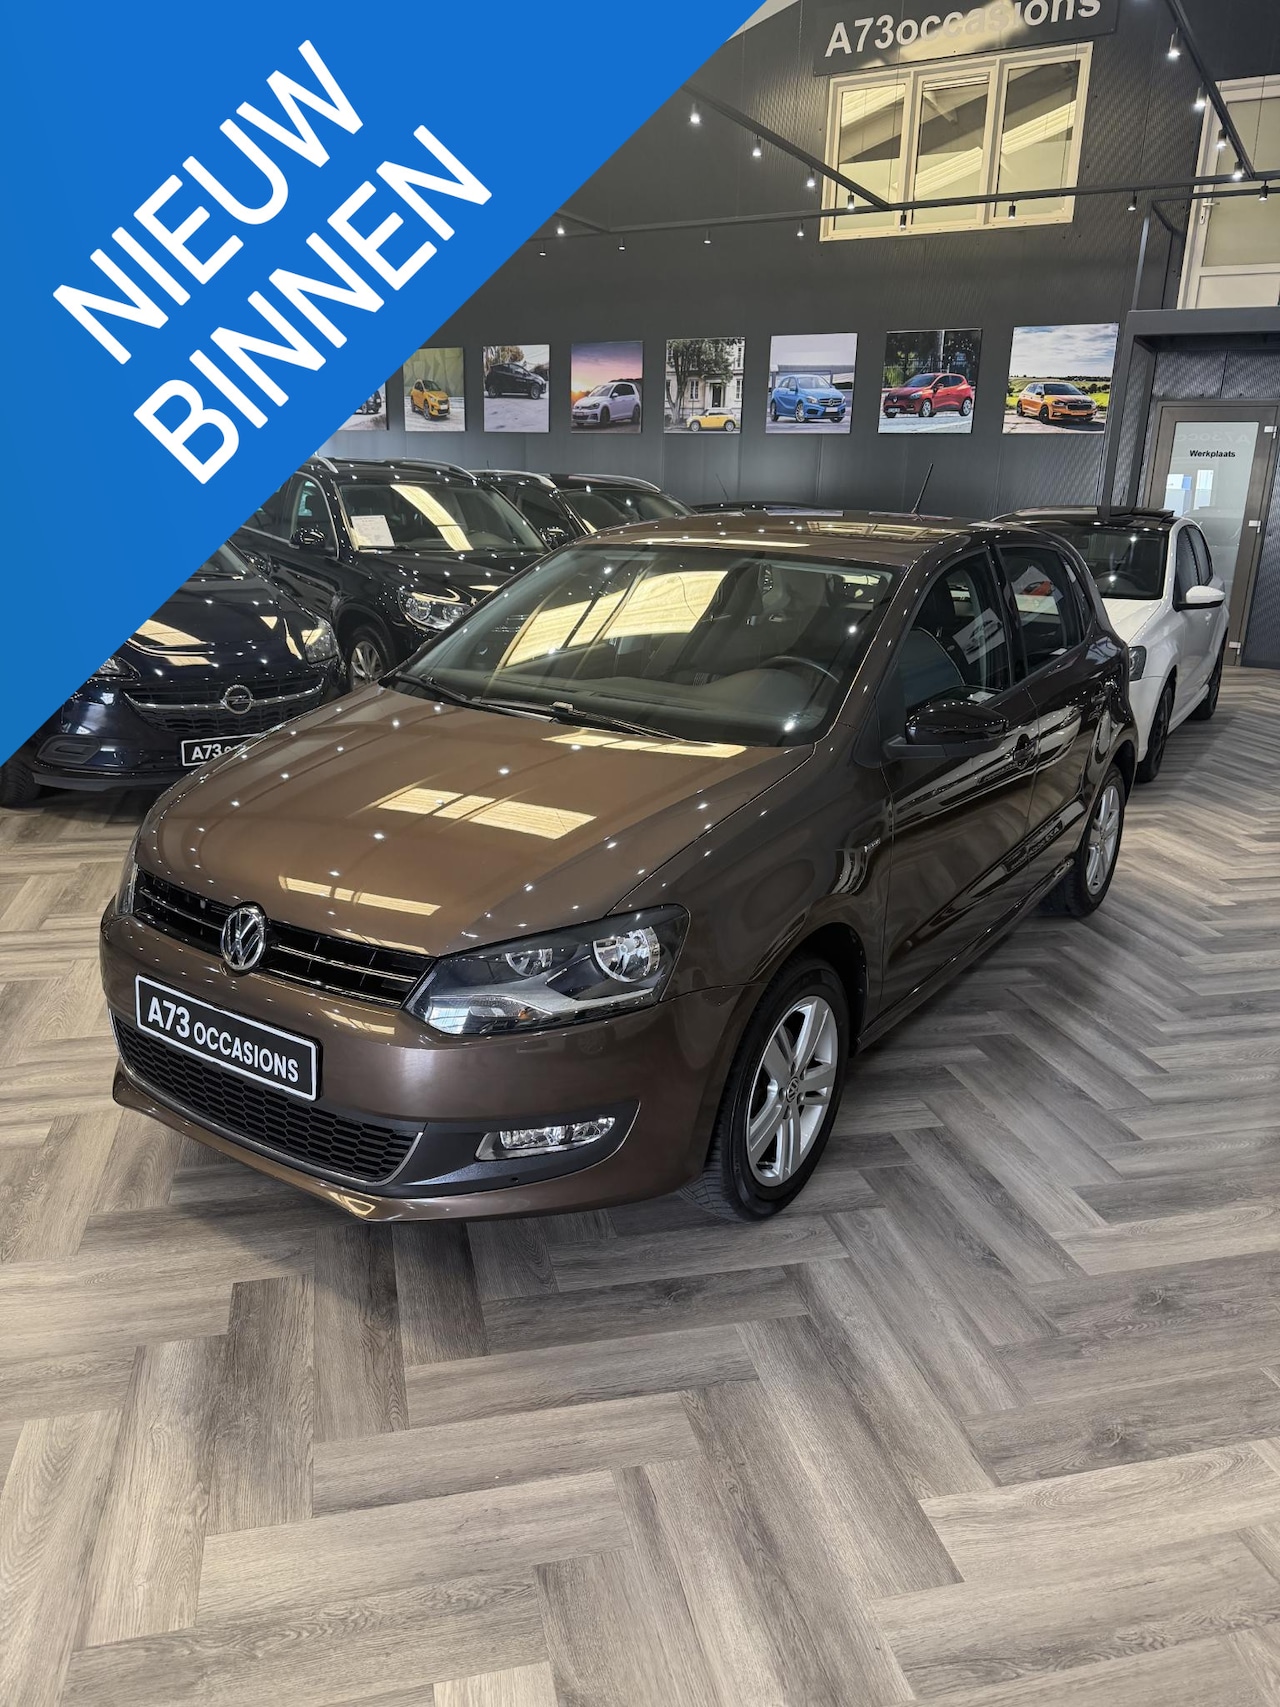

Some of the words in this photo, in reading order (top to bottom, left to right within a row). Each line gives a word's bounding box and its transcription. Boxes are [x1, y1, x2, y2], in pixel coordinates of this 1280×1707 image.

[824, 0, 1101, 58] A73occasions
[1189, 449, 1236, 459] Werkplaats
[191, 744, 222, 761] A73
[147, 996, 190, 1039] A73
[193, 1021, 299, 1083] OCCASIONS
